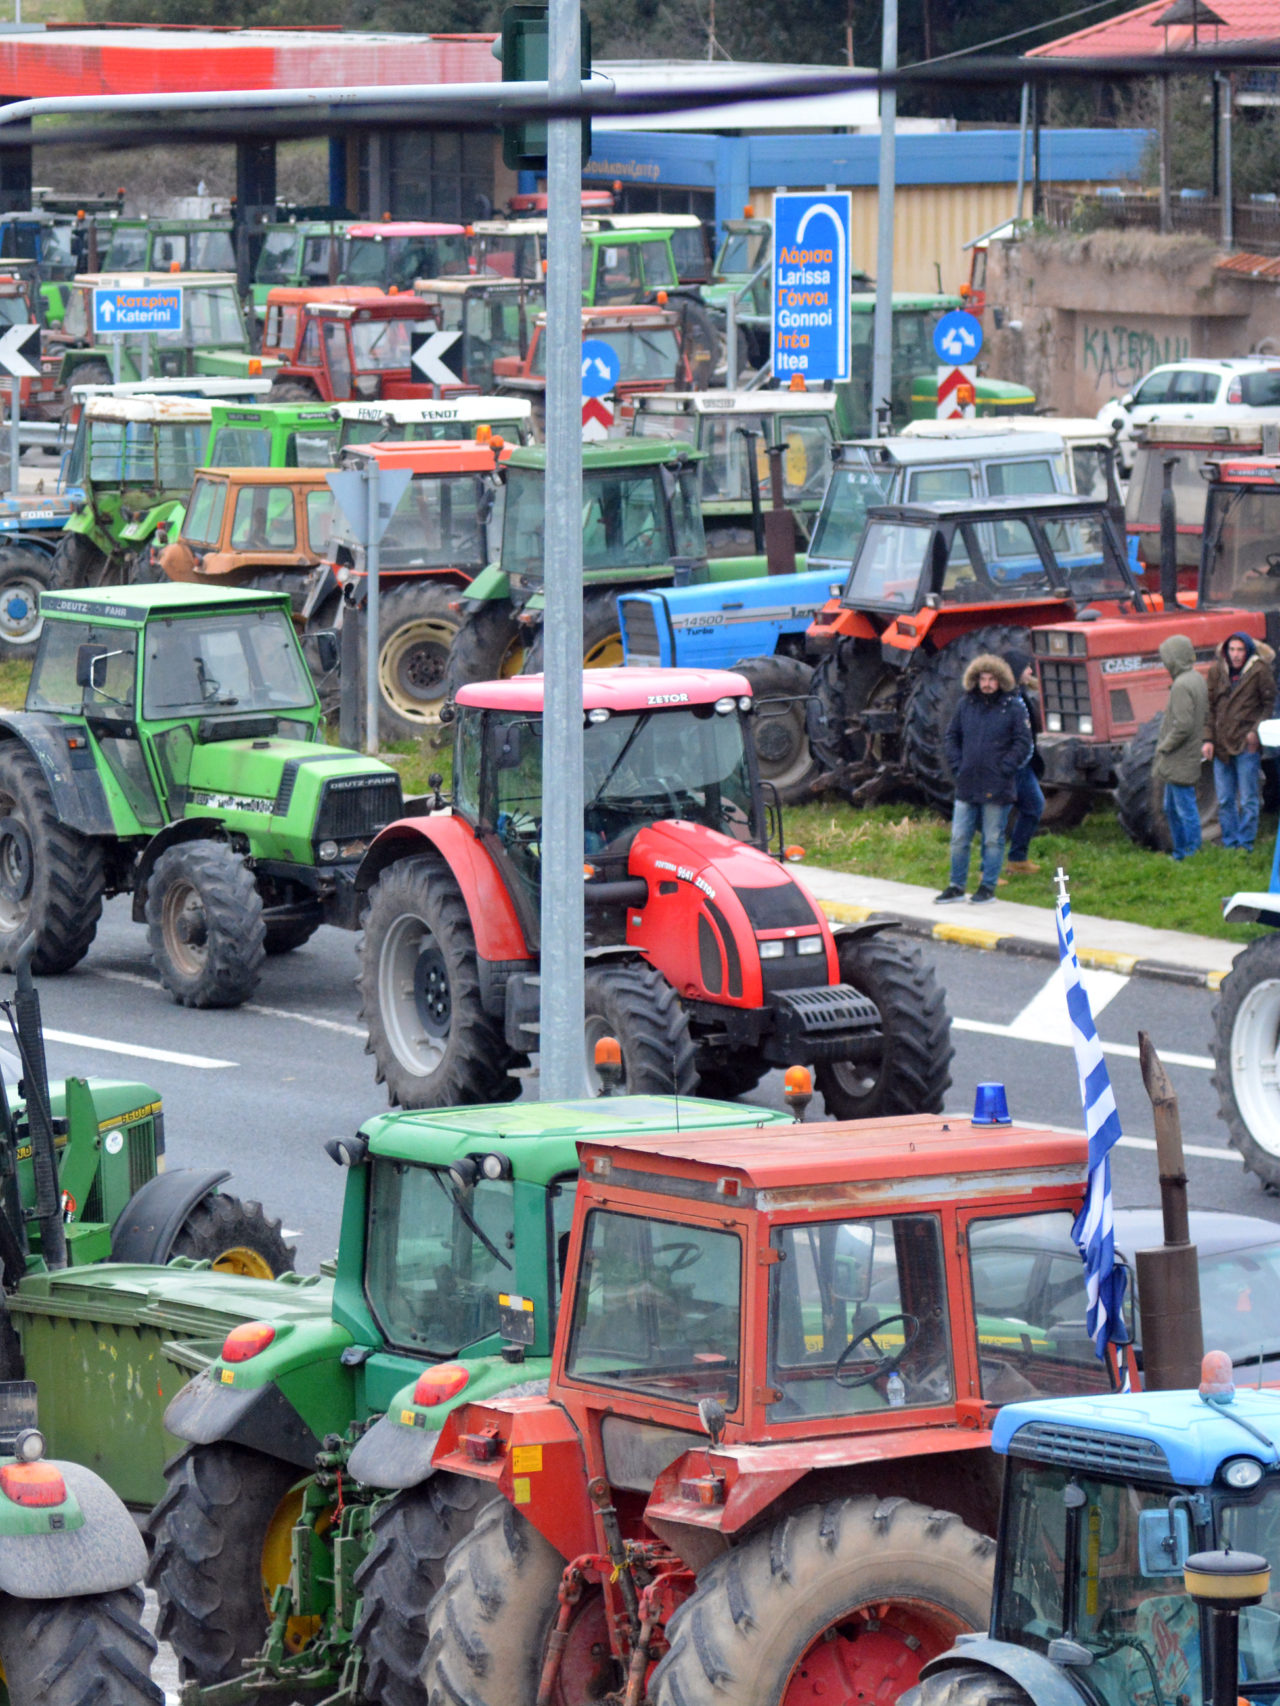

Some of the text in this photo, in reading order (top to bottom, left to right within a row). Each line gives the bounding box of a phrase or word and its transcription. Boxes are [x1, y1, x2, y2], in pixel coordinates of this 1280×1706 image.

[779, 245, 833, 268] Λάρισα
[778, 267, 831, 286] Larissa
[116, 293, 178, 310] Κατερίνη
[778, 288, 828, 306] Γόννοι
[116, 308, 171, 322] Katerini
[778, 308, 832, 328] Gonnoi
[778, 329, 810, 349] Ιτέα
[777, 351, 809, 370] Itea
[358, 407, 383, 419] FENDT
[421, 409, 459, 420] FENDT
[20, 510, 54, 520] FORD
[60, 601, 127, 617] DEUTZ FAHR
[684, 614, 723, 627] 14500
[686, 628, 714, 636] Turbo
[1104, 657, 1142, 673] CASE
[647, 693, 689, 705] ZETOR
[330, 777, 396, 790] DEUTZ-FAHR
[677, 866, 694, 881] 9641
[694, 876, 716, 900] ZETOR
[121, 1107, 147, 1124] 6600
